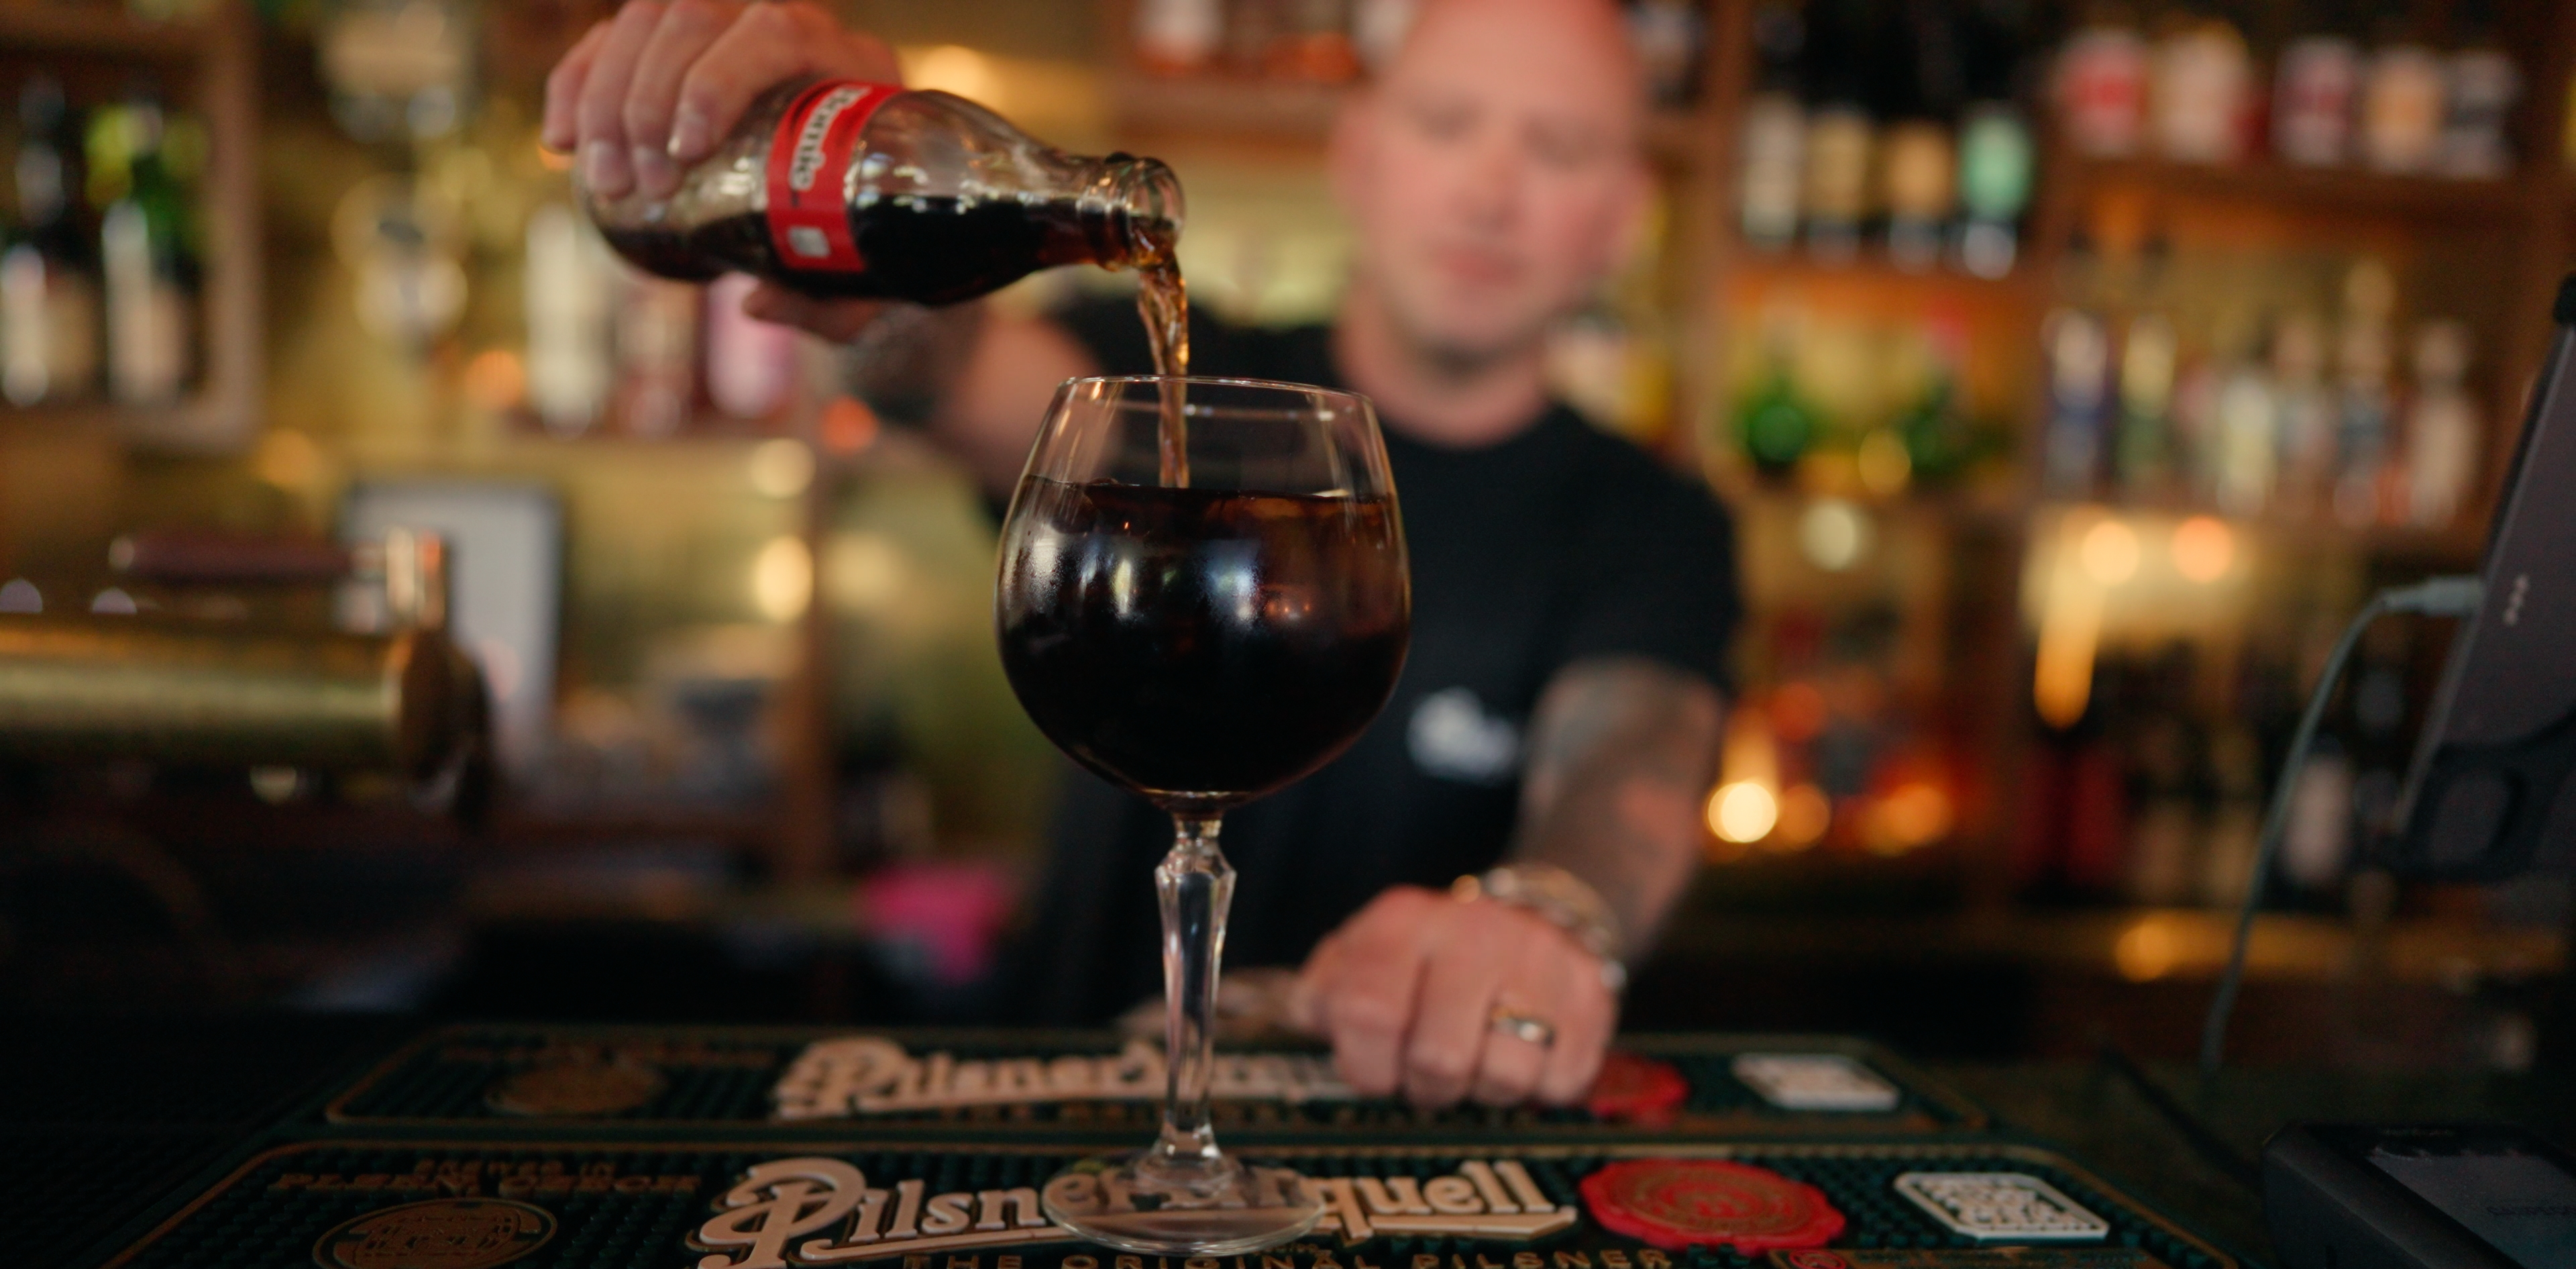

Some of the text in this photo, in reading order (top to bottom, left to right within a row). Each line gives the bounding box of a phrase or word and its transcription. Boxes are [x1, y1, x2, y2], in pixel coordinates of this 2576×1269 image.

[698, 1157, 1134, 1268] Pilsner
[1061, 1253, 1381, 1269] ORIGINAL
[1411, 1249, 1674, 1269] PILSNER
